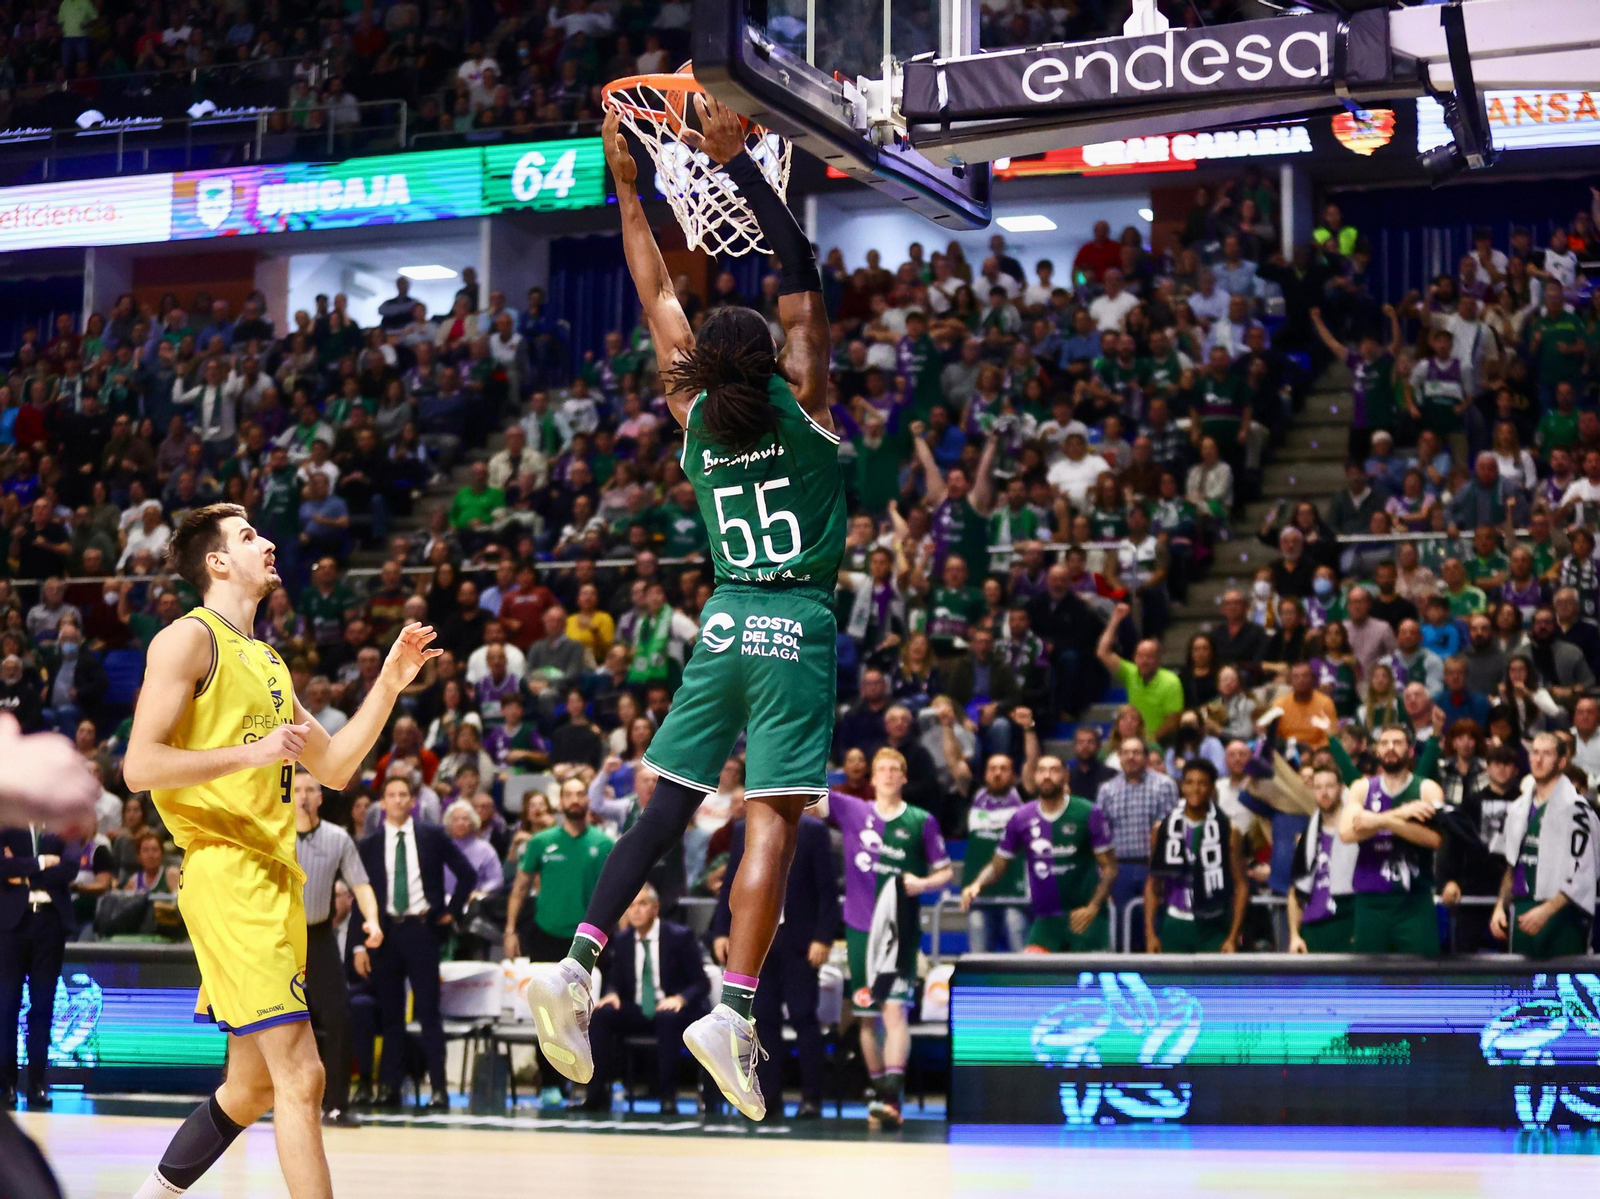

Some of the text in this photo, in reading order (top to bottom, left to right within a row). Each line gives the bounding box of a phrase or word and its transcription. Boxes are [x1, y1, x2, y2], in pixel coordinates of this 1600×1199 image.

[1022, 31, 1329, 102] endesa
[511, 149, 578, 202] 64
[713, 477, 802, 569] 55
[745, 615, 803, 637] COSTA
[742, 630, 801, 650] DEL SOL
[741, 643, 799, 662] MÁLAGA
[256, 1002, 285, 1018] SPALDING
